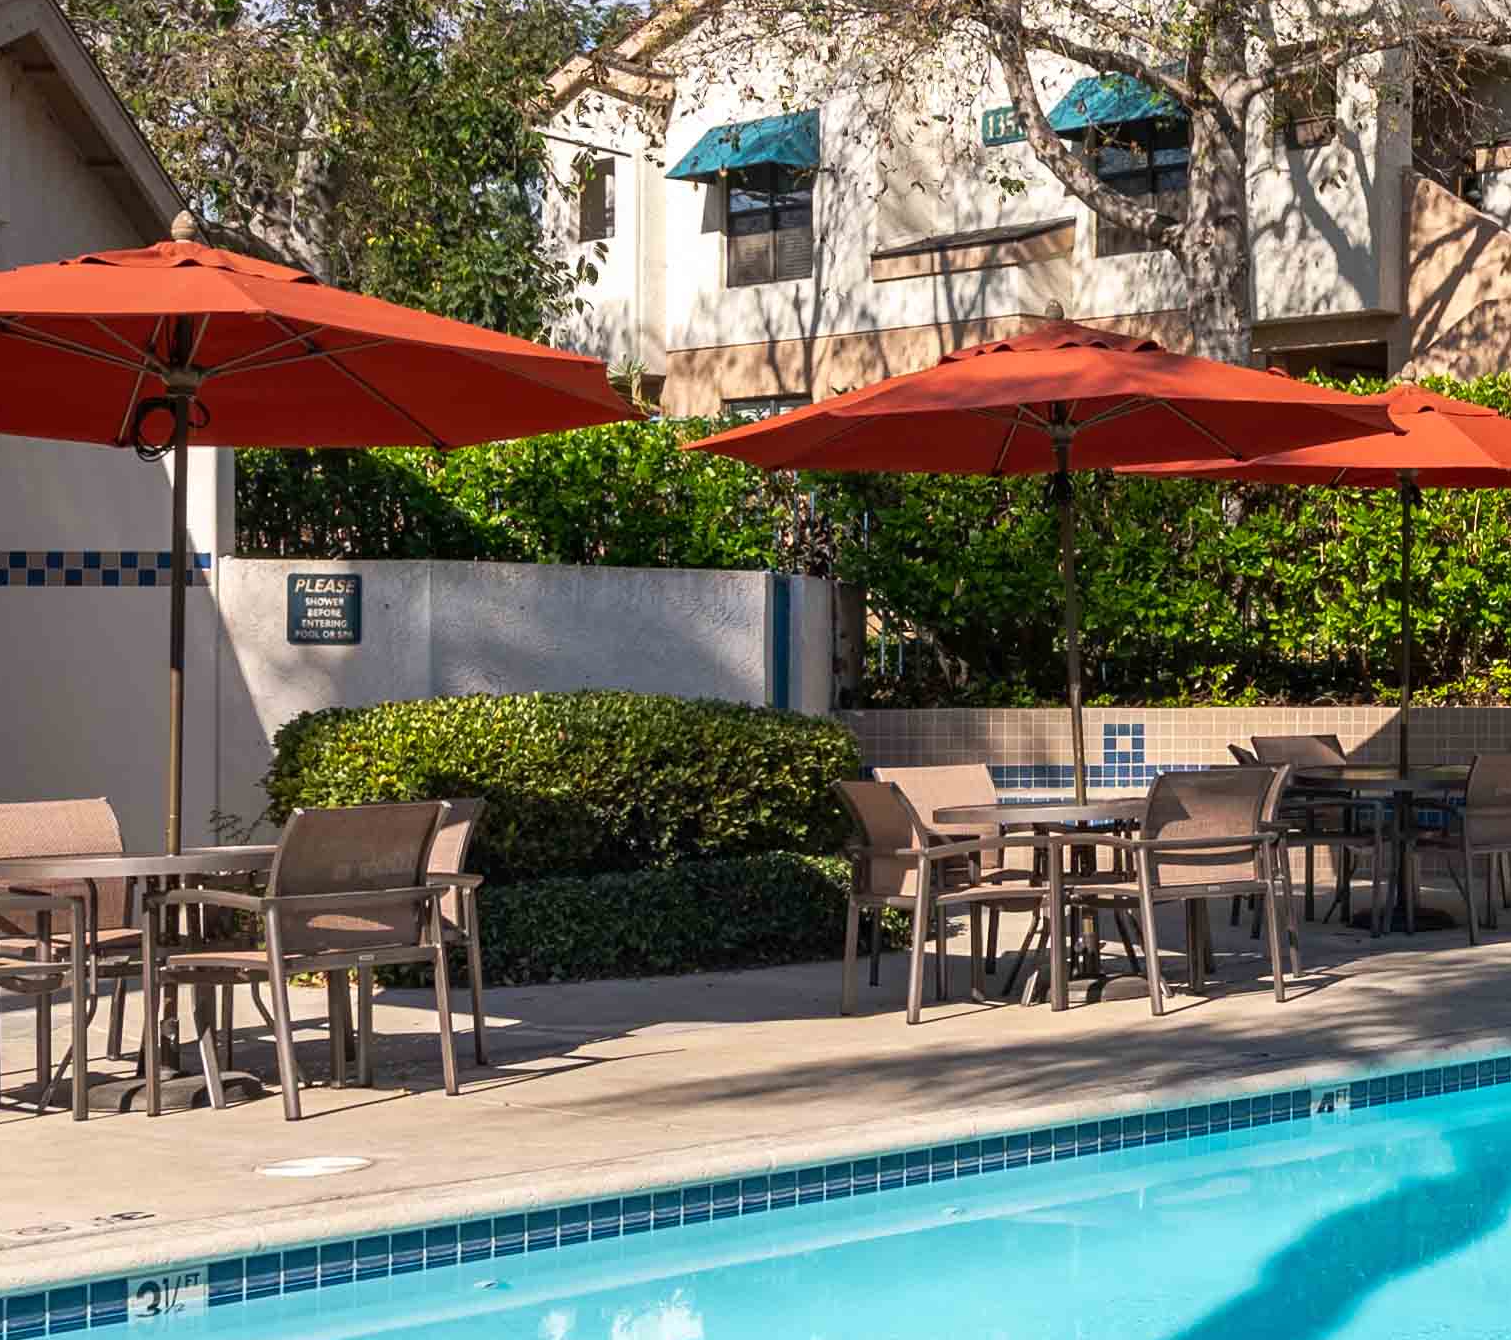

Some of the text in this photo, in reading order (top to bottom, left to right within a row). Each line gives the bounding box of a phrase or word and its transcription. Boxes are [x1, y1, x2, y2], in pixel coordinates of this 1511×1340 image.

[988, 111, 1024, 138] 135
[295, 579, 355, 593] PLEASE
[305, 597, 345, 606] SHOWER
[307, 608, 342, 618] BEFORE
[301, 619, 347, 628] ENTERING
[295, 629, 321, 638] POOL
[184, 1272, 201, 1286] FT
